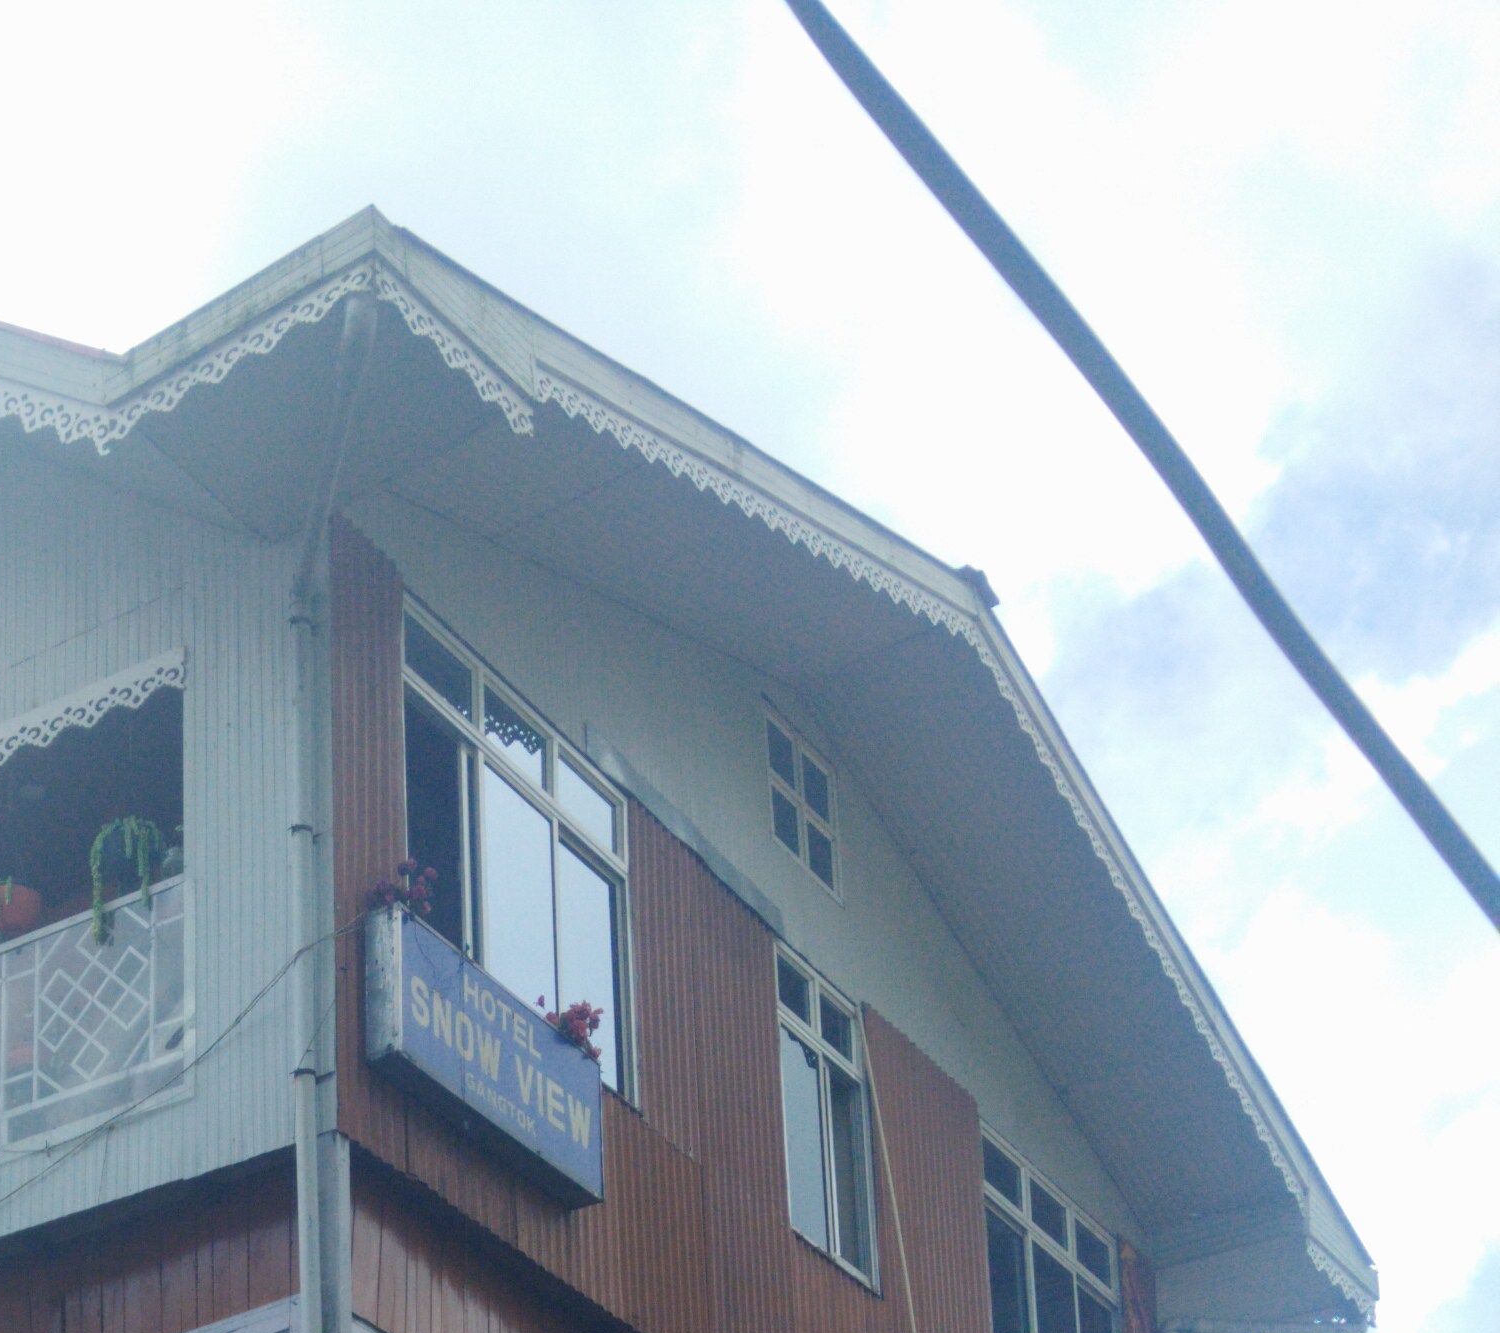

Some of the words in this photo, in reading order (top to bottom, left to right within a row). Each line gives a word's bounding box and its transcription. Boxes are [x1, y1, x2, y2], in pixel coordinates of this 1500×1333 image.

[463, 973, 542, 1060] HOTEL
[411, 975, 500, 1082] SNOW
[515, 1054, 591, 1149] VIEW
[464, 1072, 536, 1136] GANGTOK
